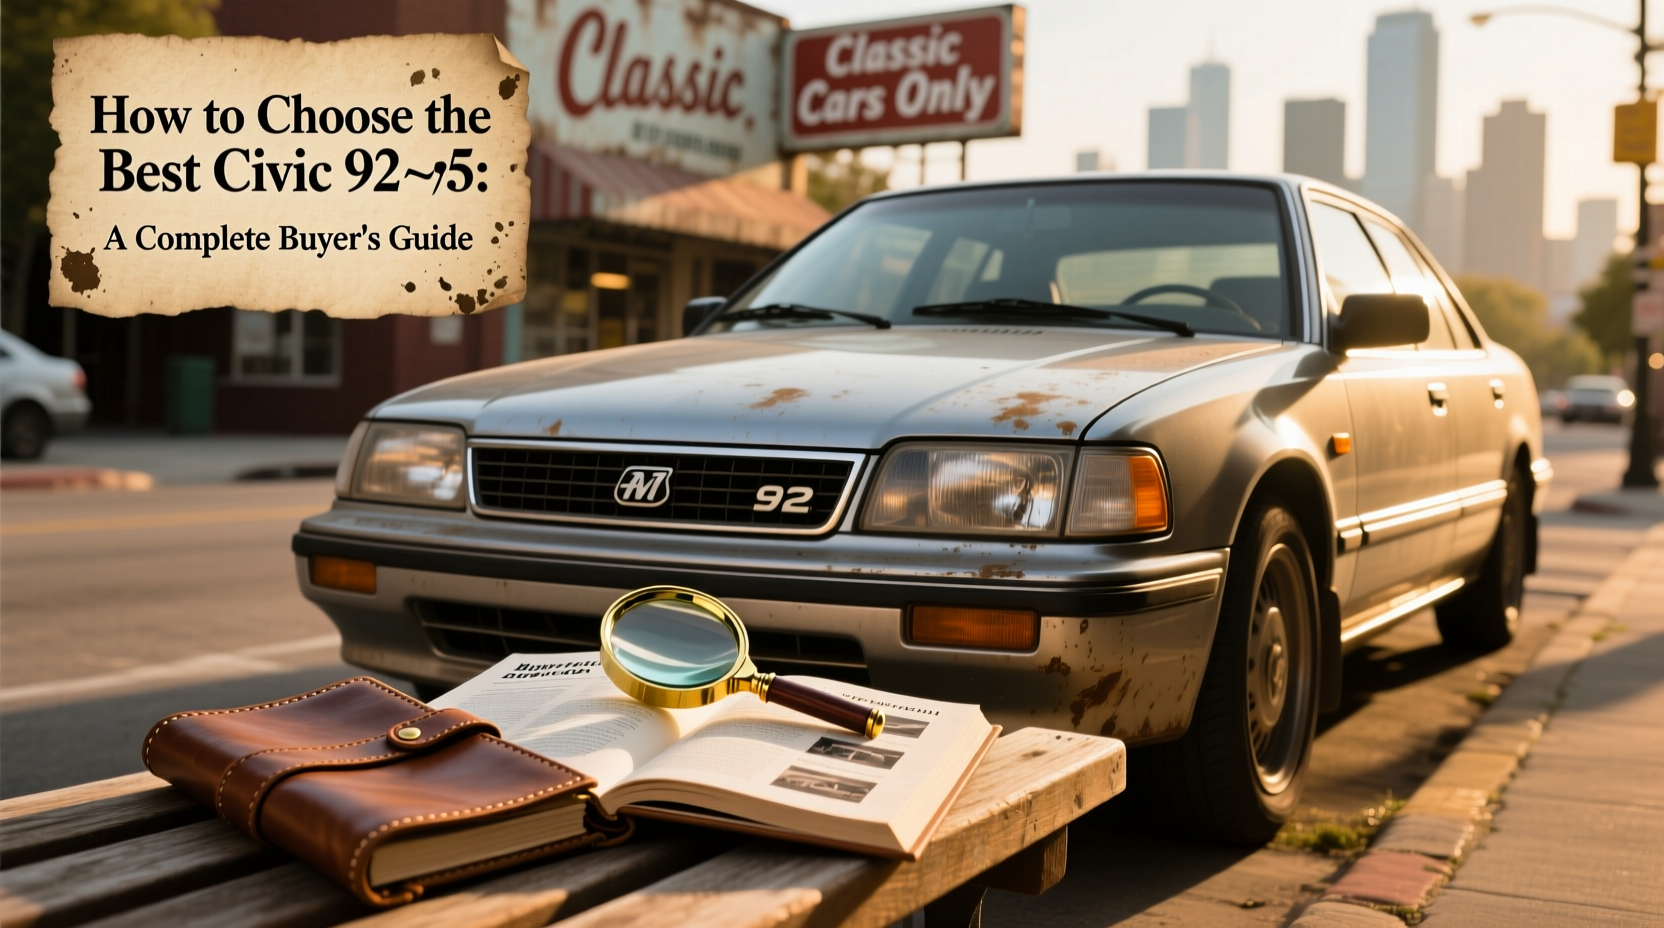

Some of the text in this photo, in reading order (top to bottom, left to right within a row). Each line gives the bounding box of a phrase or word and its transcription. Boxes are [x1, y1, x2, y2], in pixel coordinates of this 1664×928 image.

[825, 23, 962, 78] Classic
[798, 66, 995, 126] Cars Only
[753, 485, 814, 514] 92
